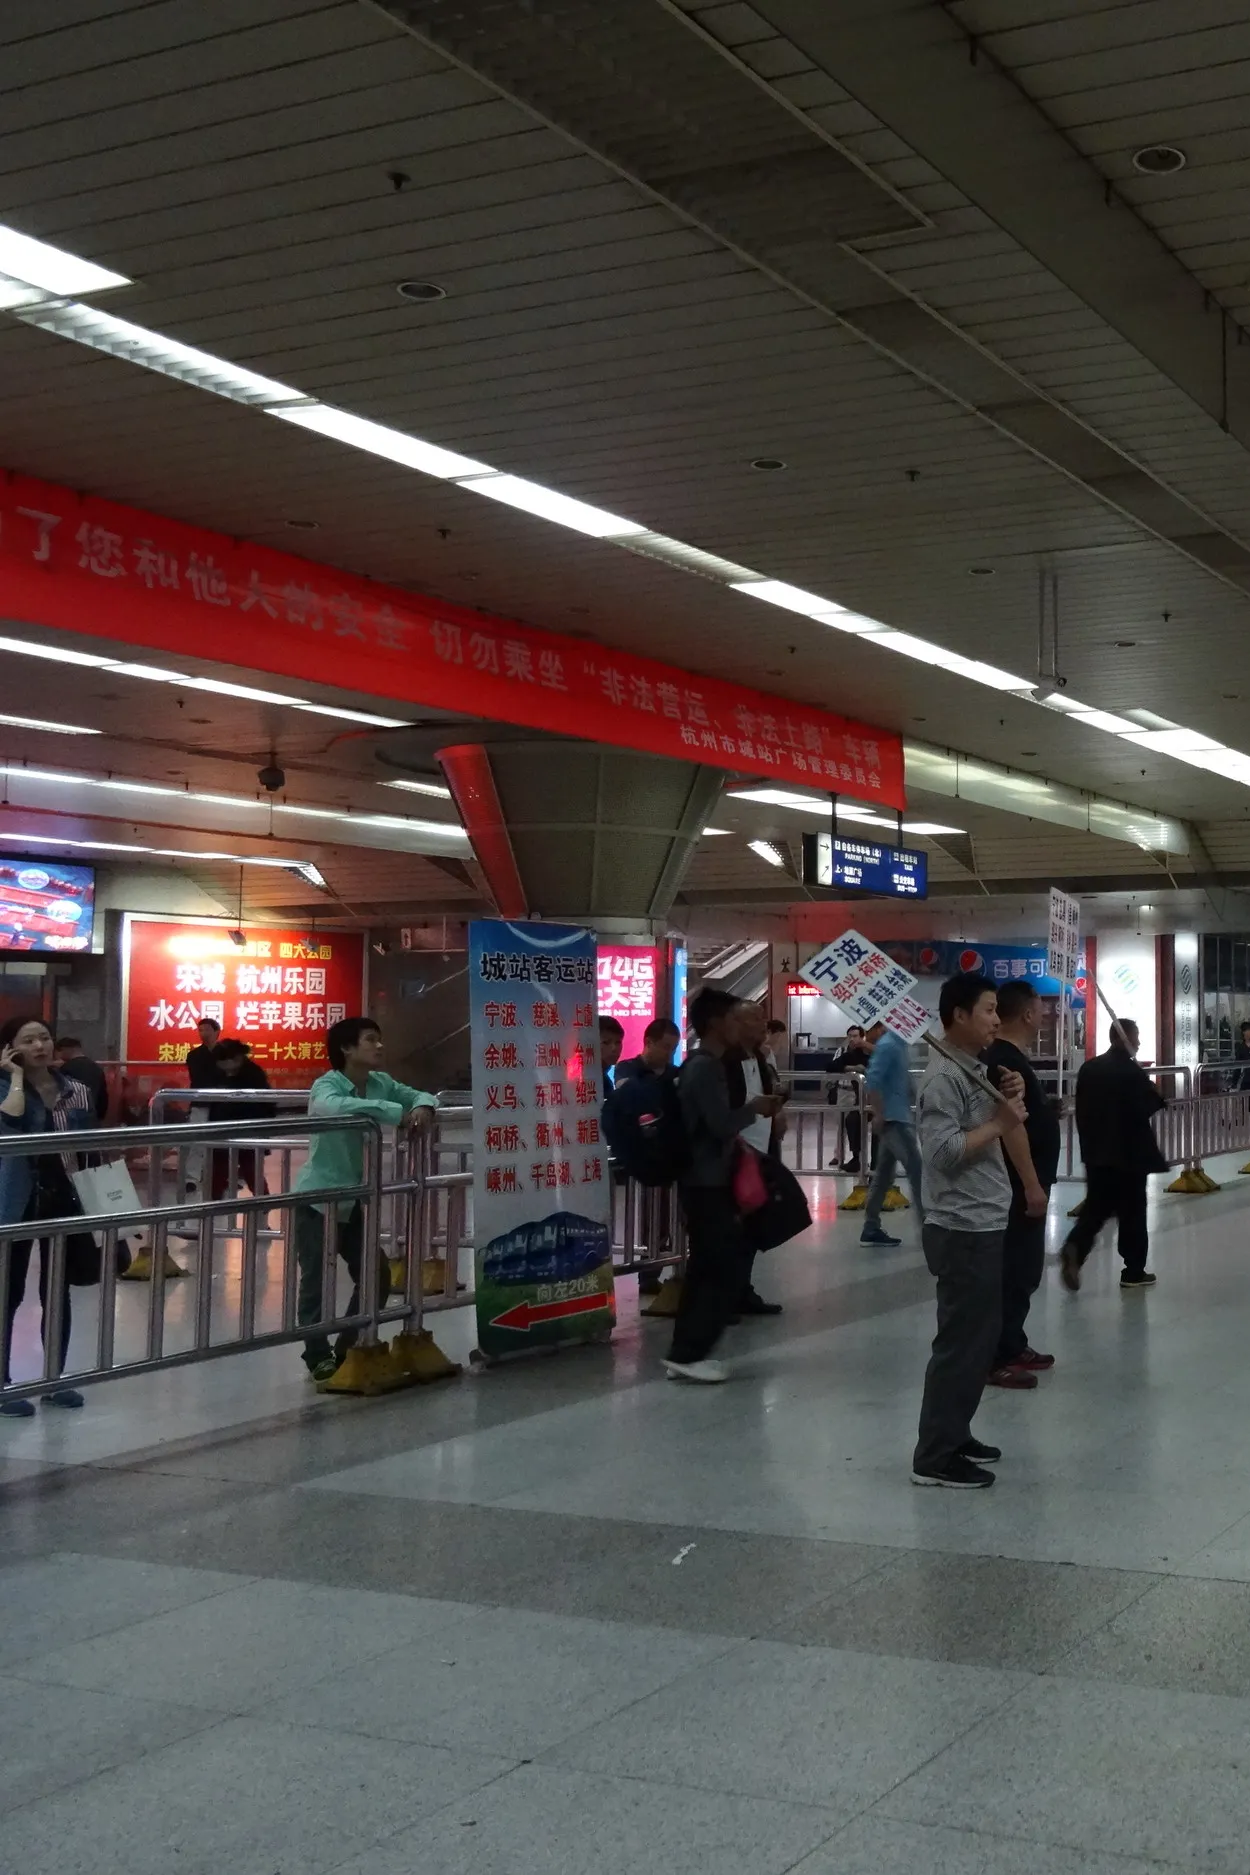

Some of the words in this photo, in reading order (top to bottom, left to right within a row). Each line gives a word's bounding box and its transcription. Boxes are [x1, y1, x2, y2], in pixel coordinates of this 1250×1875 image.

[0, 506, 412, 653] 了您和他人的安全
[680, 723, 881, 789] 杭州市城站广场管理委员会
[480, 953, 595, 985] 城站客运站
[809, 938, 869, 982] 宁波
[992, 958, 1048, 979] 百事可
[175, 963, 226, 993] 宋城
[236, 966, 326, 996] 杭州乐园
[830, 973, 865, 1004] 绍兴
[856, 952, 890, 979] 柯桥
[149, 999, 225, 1030] 水公园
[236, 1001, 346, 1031] 烂苹果乐园
[484, 1001, 594, 1030] 宁波、慈溪、上虞
[484, 1081, 598, 1111] 义乌、东阳、绍兴
[536, 1273, 599, 1302] 向左20米
